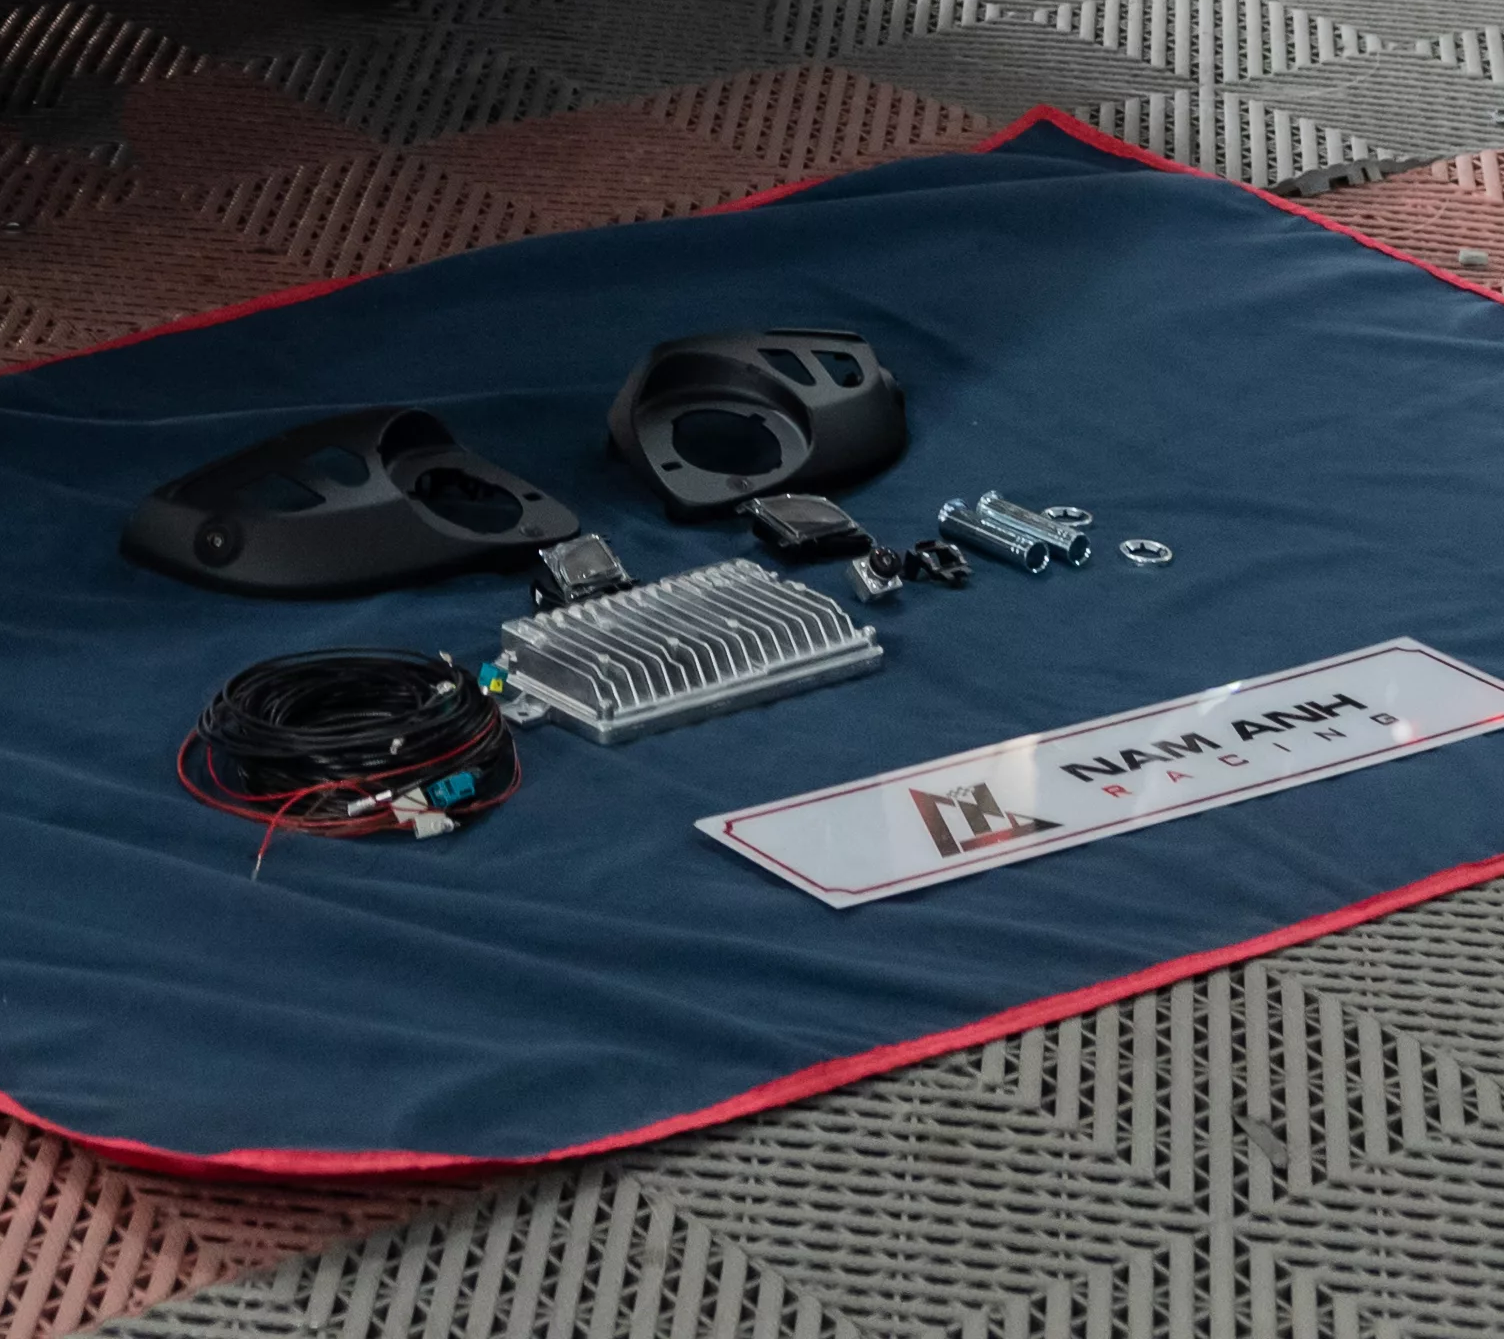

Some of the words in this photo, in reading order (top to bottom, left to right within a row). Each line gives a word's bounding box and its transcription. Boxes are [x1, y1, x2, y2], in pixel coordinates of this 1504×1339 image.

[1058, 732, 1223, 783] NAM
[1230, 692, 1369, 742] ANH
[1100, 712, 1399, 799] RACING
